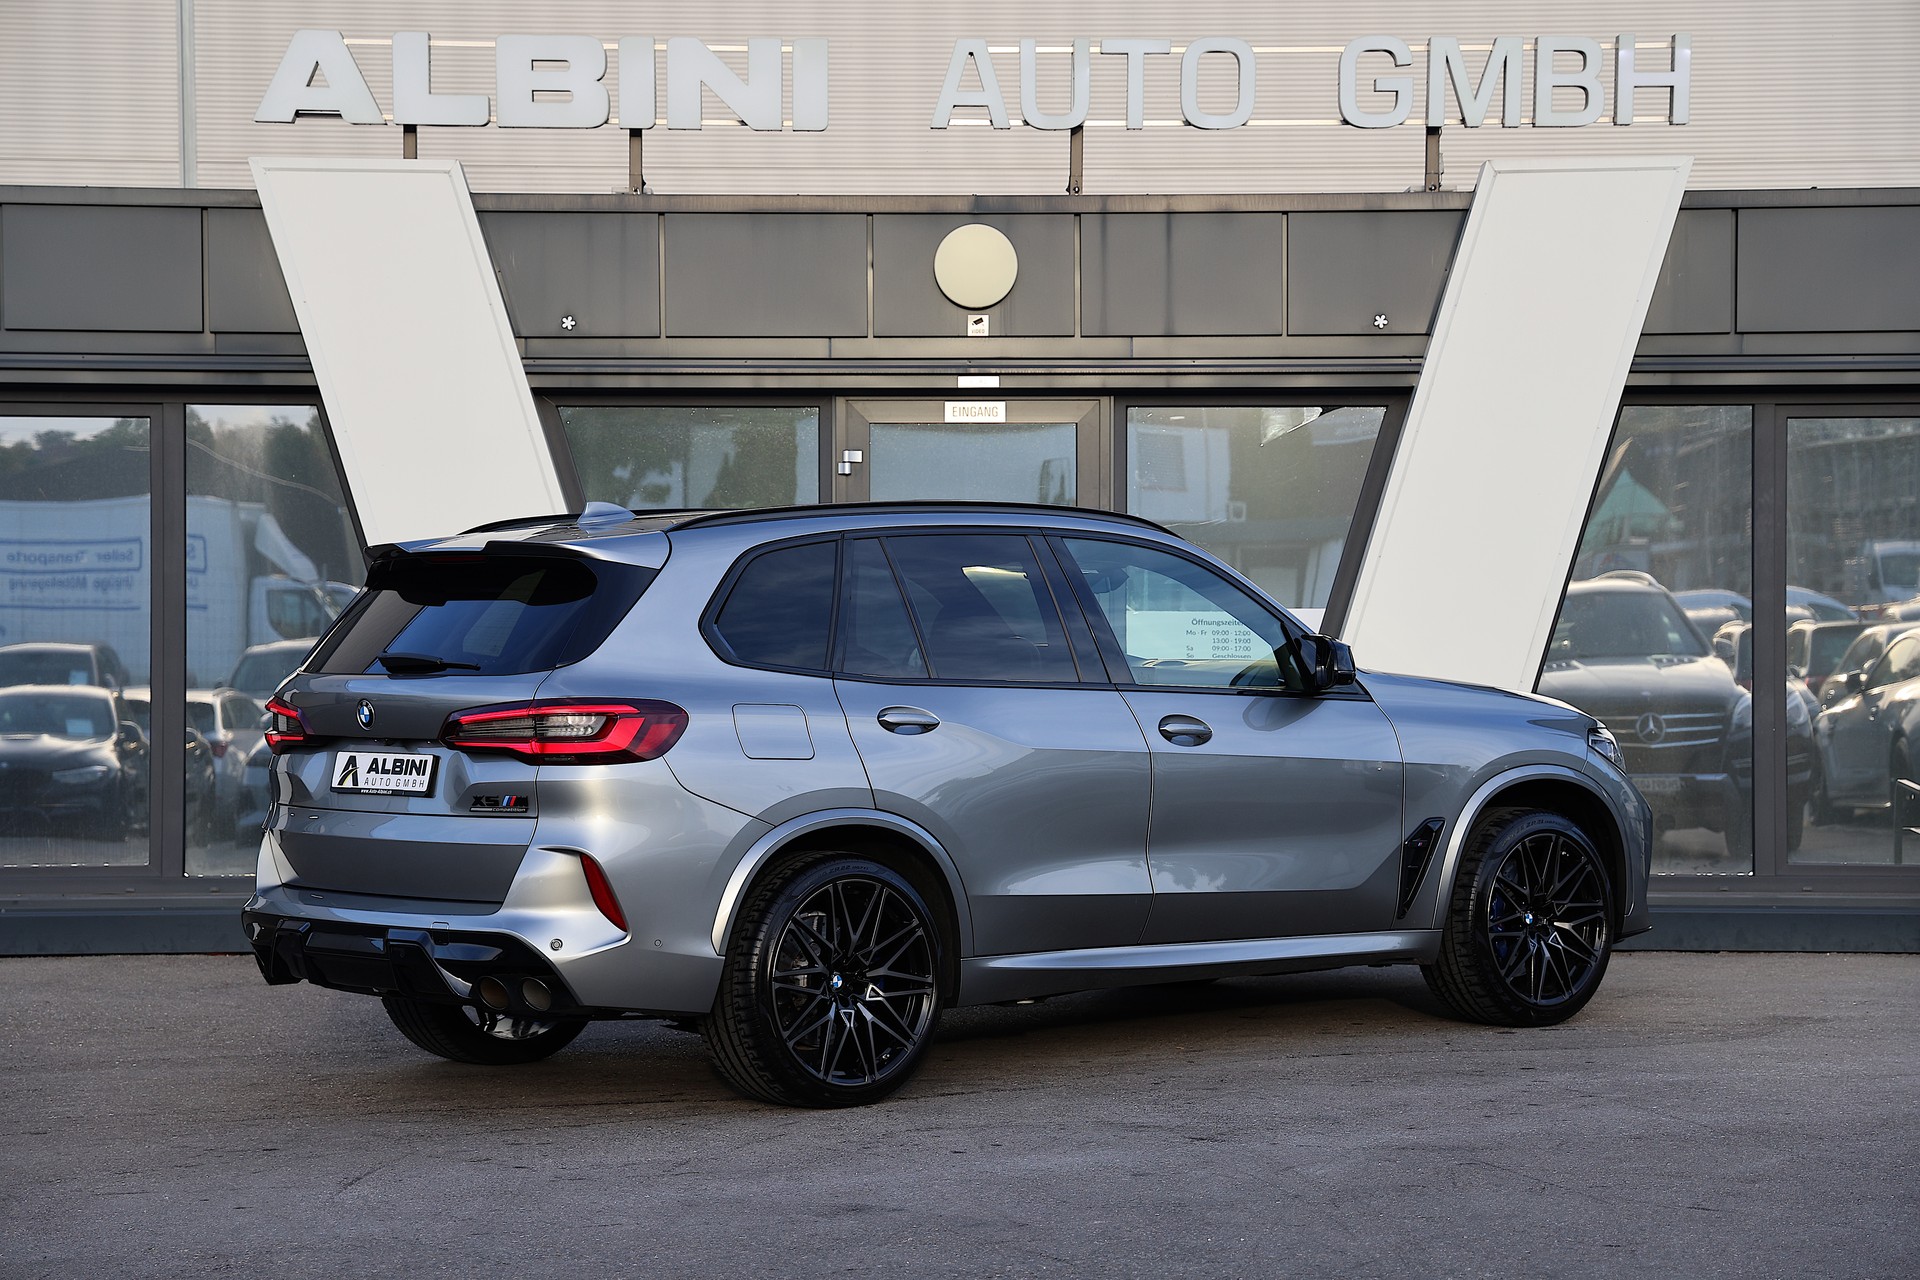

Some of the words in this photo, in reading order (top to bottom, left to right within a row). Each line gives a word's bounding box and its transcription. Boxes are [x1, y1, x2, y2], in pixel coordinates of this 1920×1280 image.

[253, 29, 829, 131] ALBINI
[930, 37, 1256, 130] AUTO
[1339, 34, 1692, 129] GMBH
[952, 406, 999, 417] EINGANG
[1191, 618, 1242, 627] Öffnungszeite
[366, 757, 428, 776] ALBINI
[363, 777, 391, 787] AUTO
[395, 778, 425, 788] GMBH
[471, 795, 499, 806] X5
